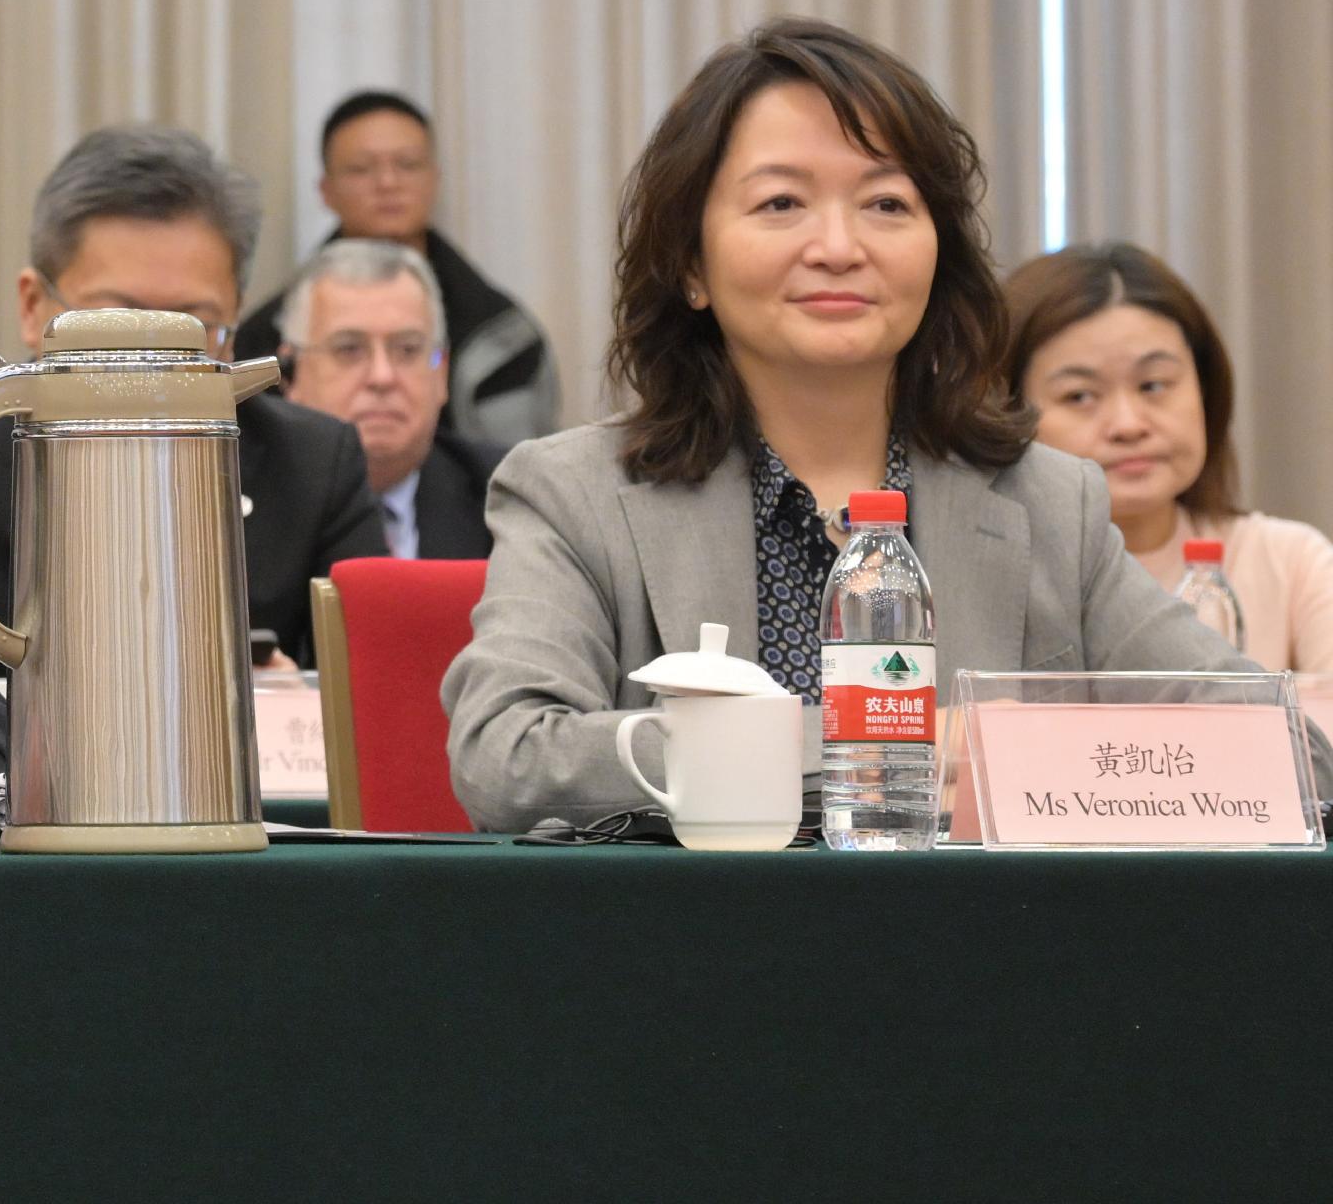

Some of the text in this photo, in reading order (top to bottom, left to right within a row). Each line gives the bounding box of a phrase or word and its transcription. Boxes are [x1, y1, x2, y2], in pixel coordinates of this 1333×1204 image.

[865, 696, 925, 714] 农夫山泉
[865, 715, 925, 725] NONGFU SPRING
[1089, 742, 1195, 778] 黃凱怡
[1023, 791, 1271, 824] Ms Veronica Wong
